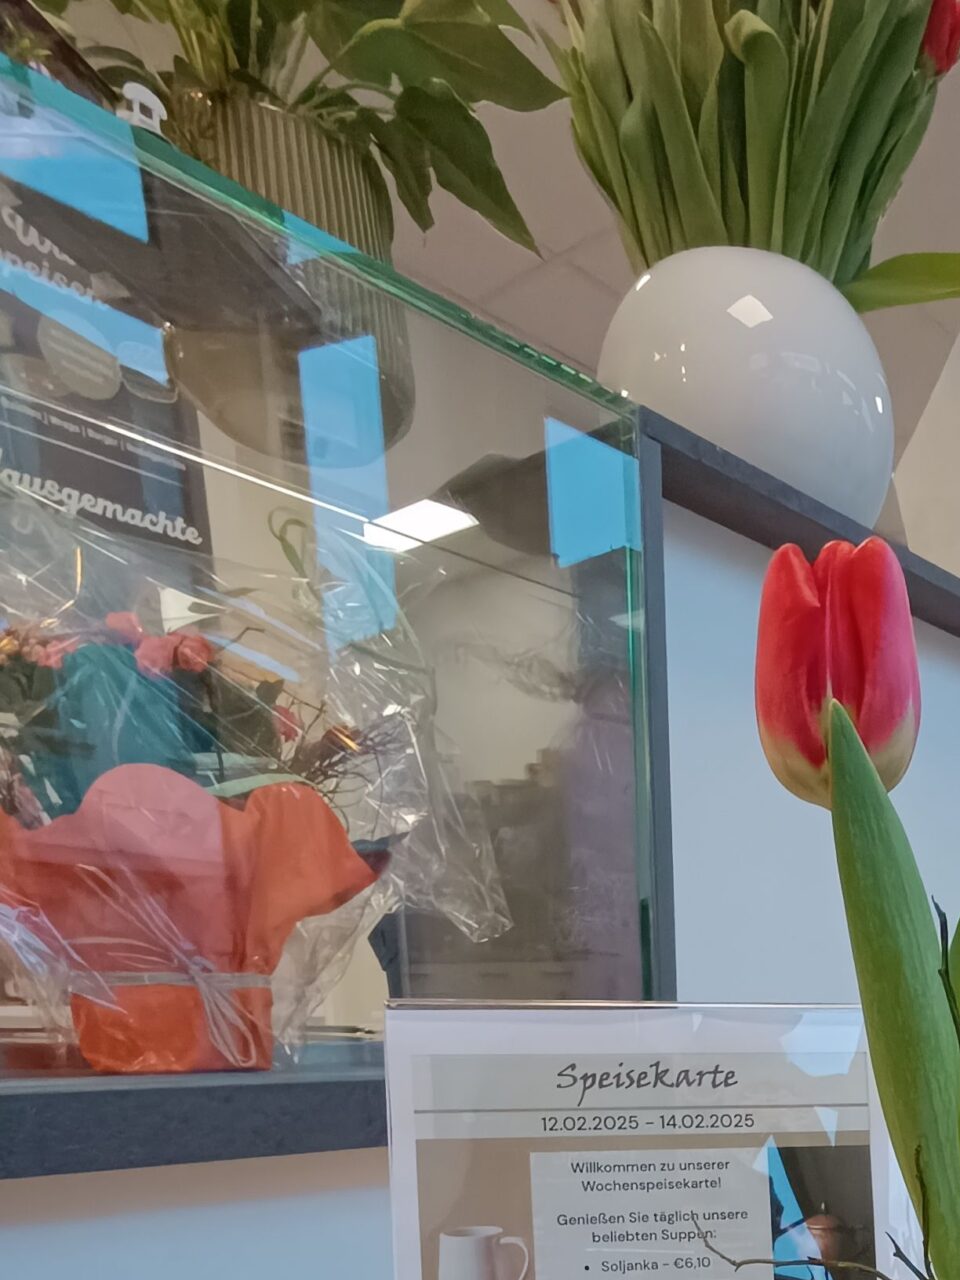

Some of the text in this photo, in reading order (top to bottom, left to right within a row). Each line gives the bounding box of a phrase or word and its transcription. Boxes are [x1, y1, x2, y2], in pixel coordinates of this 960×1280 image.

[556, 1060, 739, 1107] Speisekarte
[541, 1115, 639, 1132] 12.02.2025
[659, 1113, 755, 1129] 14.02.2025
[570, 1160, 731, 1174] Willkommen zu unserer
[581, 1177, 722, 1193] Wochenspeisekarte!
[557, 1209, 749, 1227] Genießen Sie täglich unsere
[591, 1228, 717, 1243] beliebten Suppen:
[601, 1256, 659, 1274] Soljanka
[673, 1256, 712, 1270] €6,10
